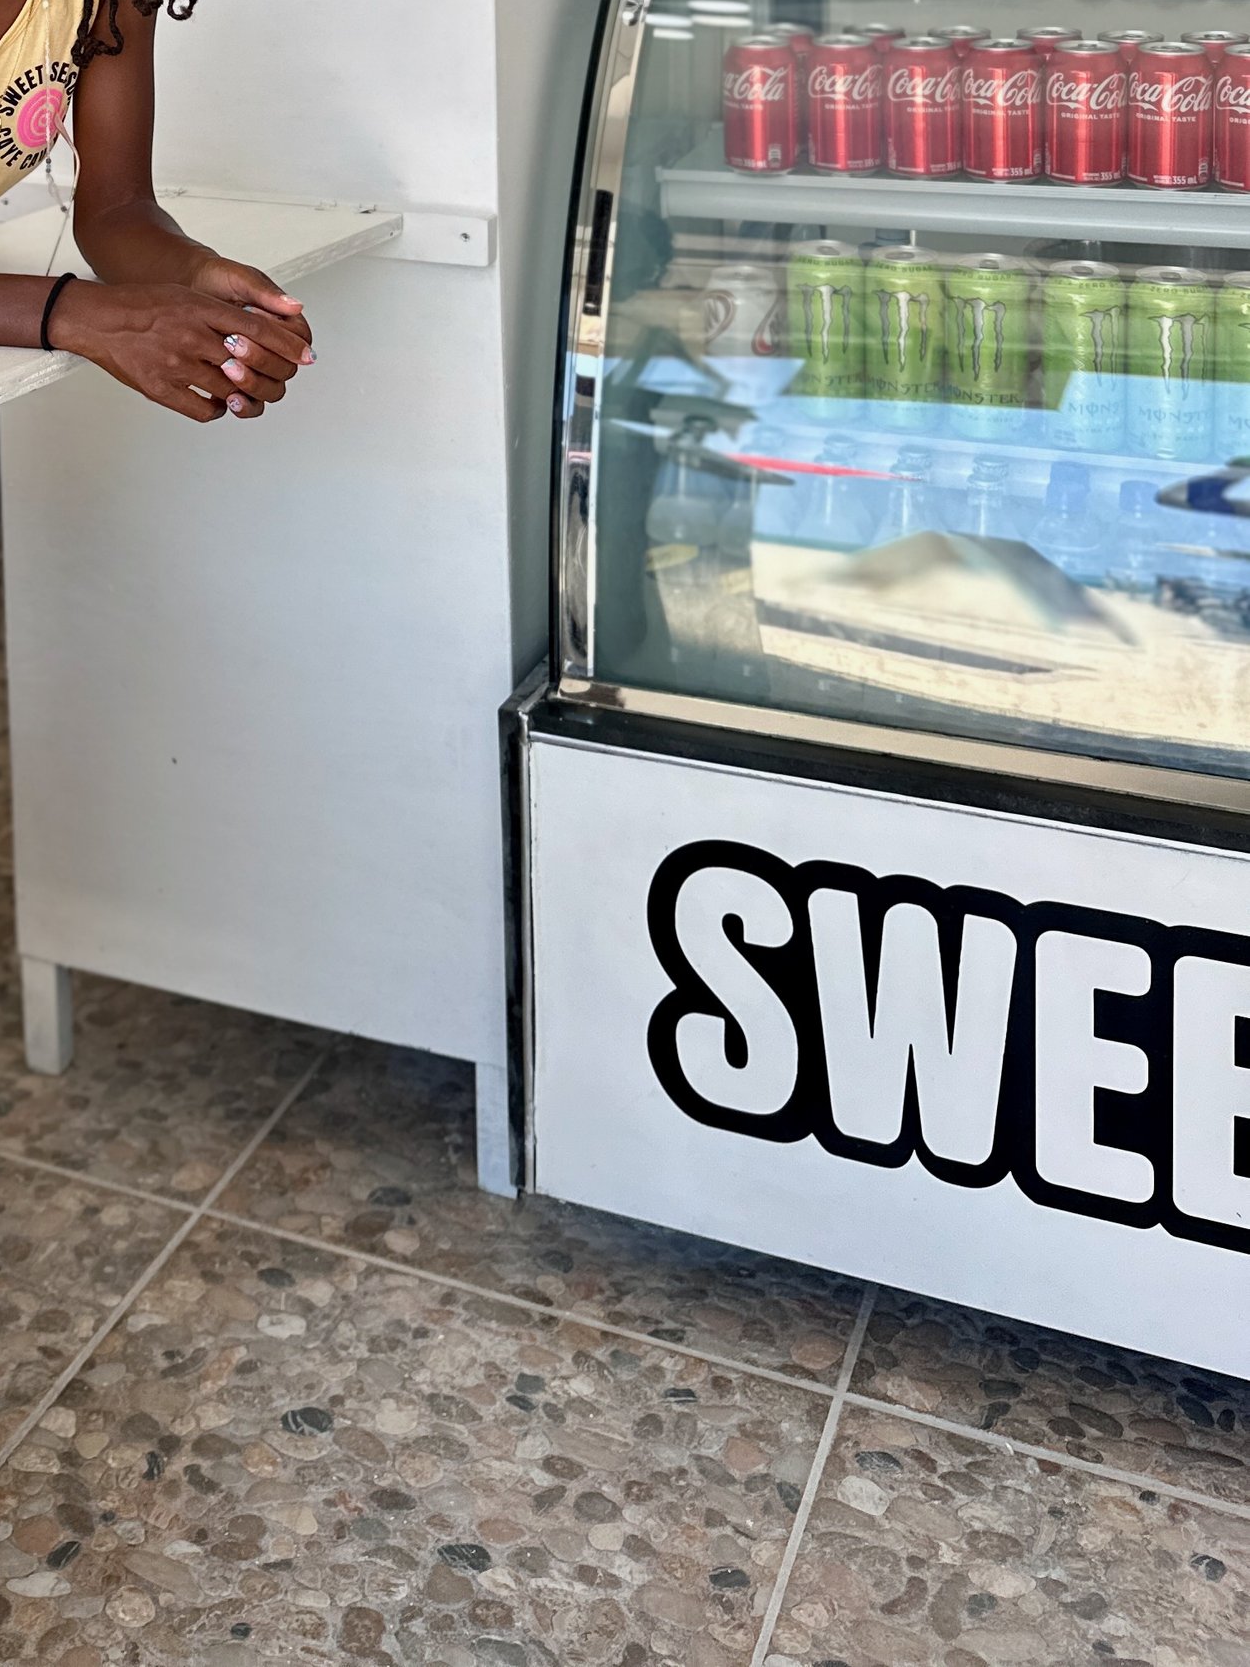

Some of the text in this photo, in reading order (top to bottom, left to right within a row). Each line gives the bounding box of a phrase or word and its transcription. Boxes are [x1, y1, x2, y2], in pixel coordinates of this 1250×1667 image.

[0, 65, 44, 116] SWEET
[1010, 167, 1023, 176] 355
[1172, 175, 1186, 184] 355
